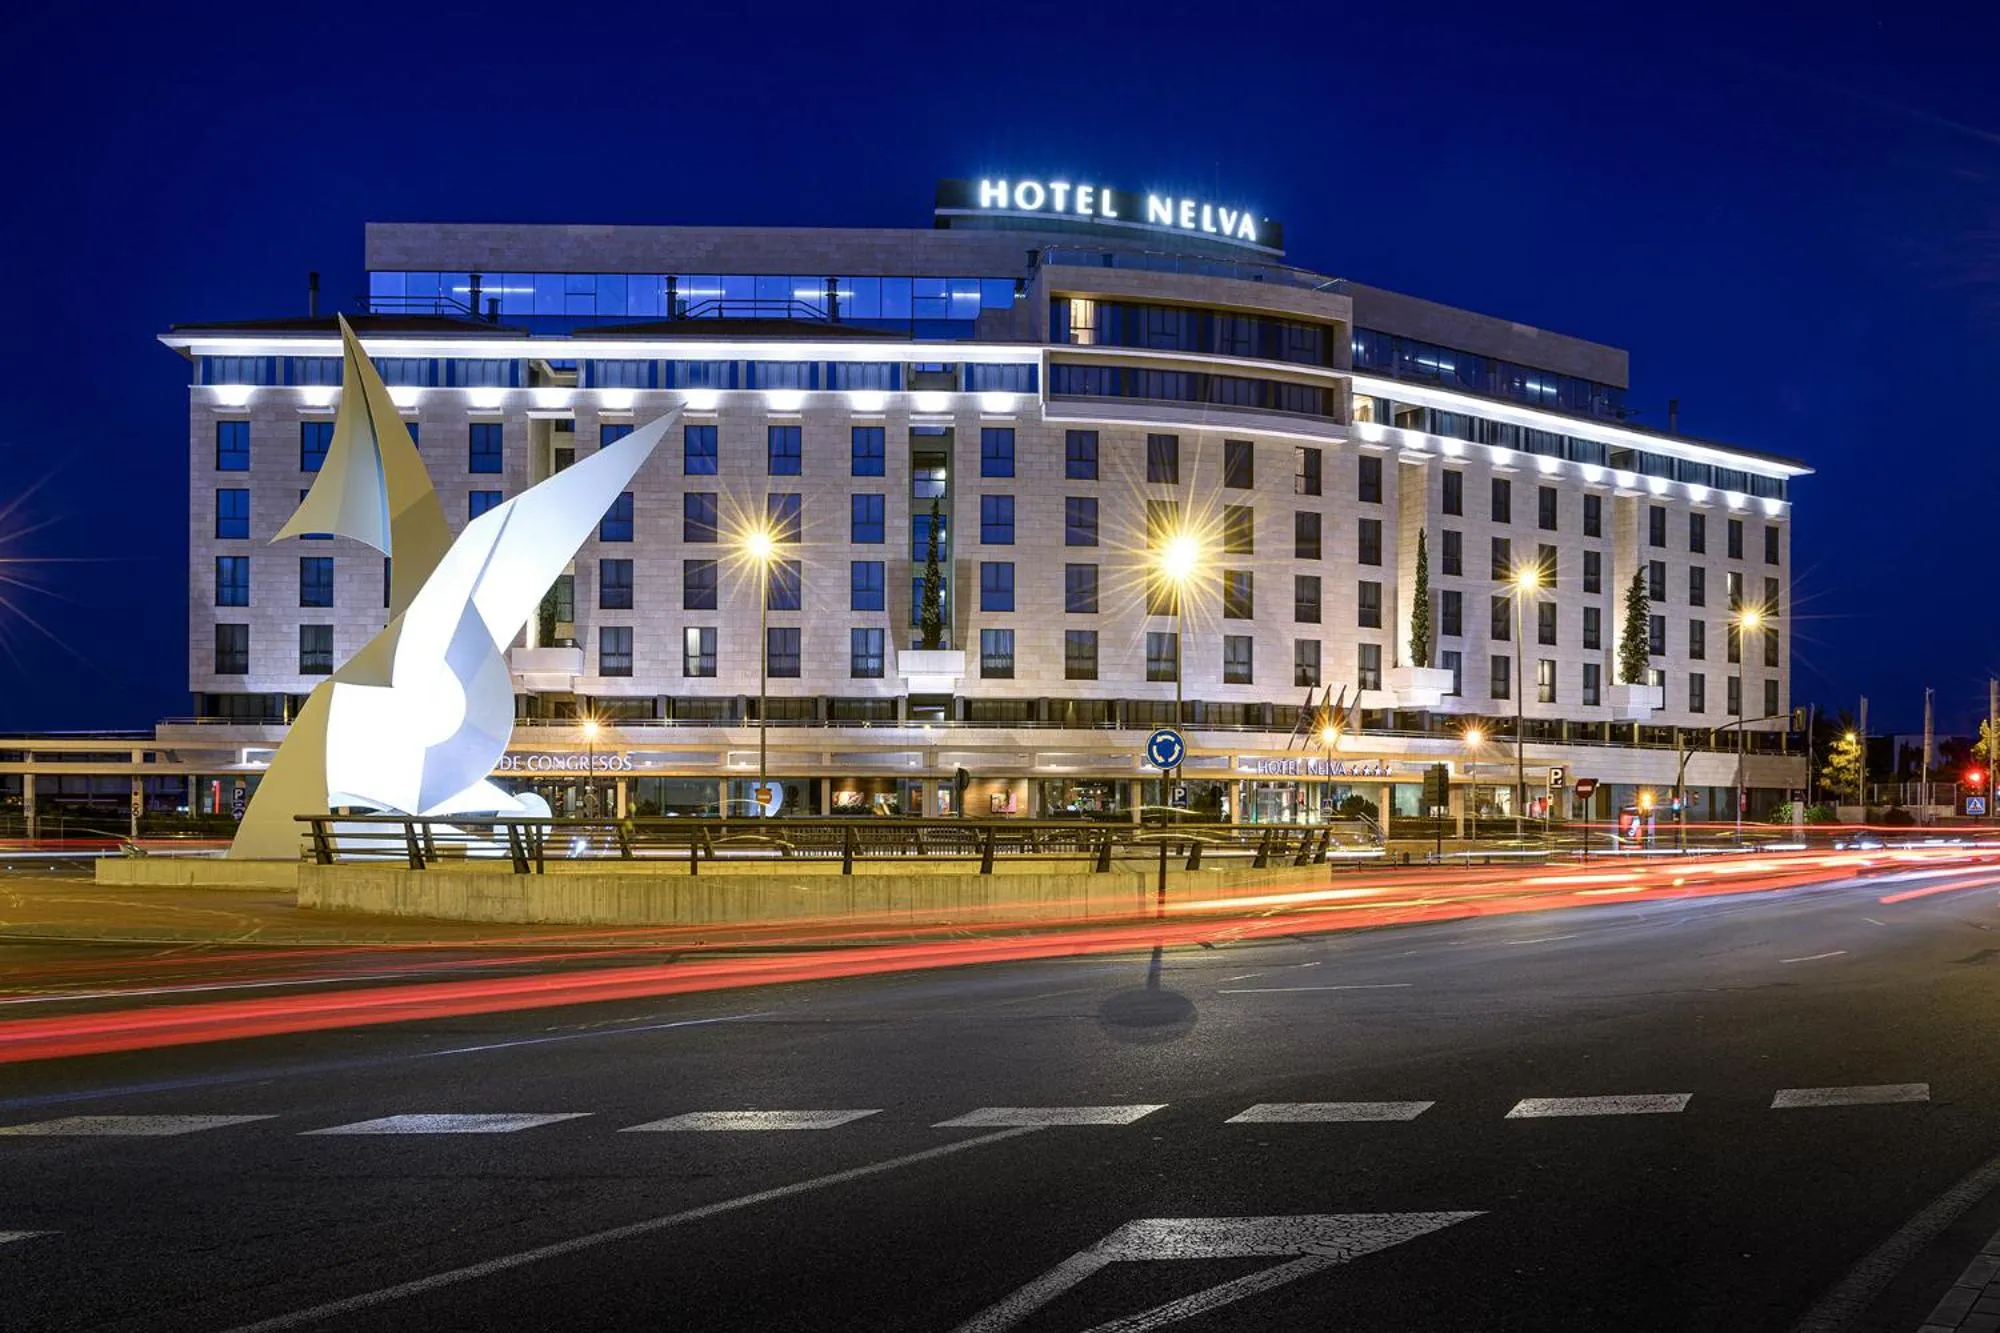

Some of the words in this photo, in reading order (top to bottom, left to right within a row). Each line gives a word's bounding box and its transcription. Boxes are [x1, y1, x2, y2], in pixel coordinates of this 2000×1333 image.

[979, 179, 1118, 218] HOTEL
[1148, 194, 1257, 242] NELVA
[500, 756, 521, 770] DE
[527, 755, 632, 771] CONGRESOS
[1257, 759, 1301, 775] HOTEL
[1307, 758, 1346, 775] NELVA
[1551, 769, 1562, 785] P
[234, 789, 243, 800] P
[1175, 788, 1185, 801] P
